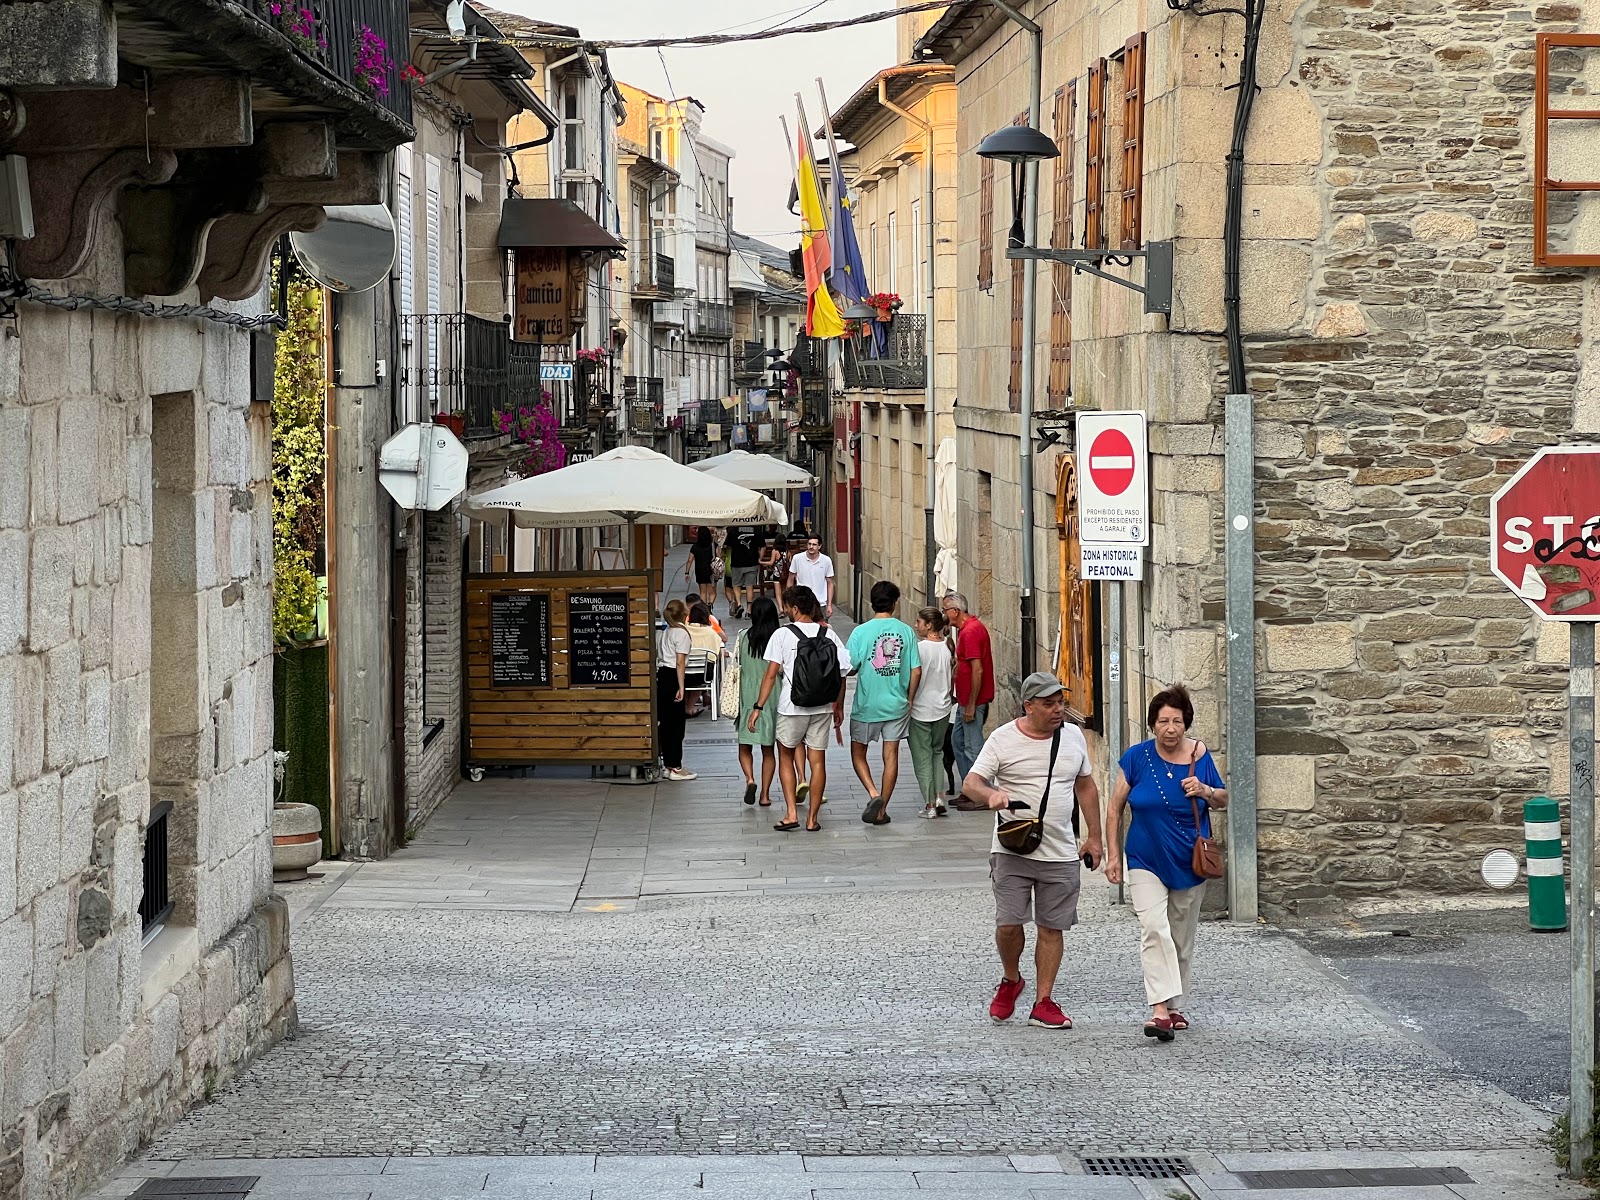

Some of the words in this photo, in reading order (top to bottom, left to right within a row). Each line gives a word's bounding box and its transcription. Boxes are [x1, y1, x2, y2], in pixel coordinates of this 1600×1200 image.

[519, 282, 562, 304] Camiño
[540, 366, 570, 378] IDAS
[571, 453, 592, 463] ATM
[1086, 508, 1116, 516] PROHIBIDO
[1116, 508, 1124, 516] EL
[1104, 525, 1126, 533] GARAJE
[1083, 550, 1101, 561] ZONA
[1102, 550, 1138, 561] HISTORICA
[1088, 565, 1134, 577] PEATONAL
